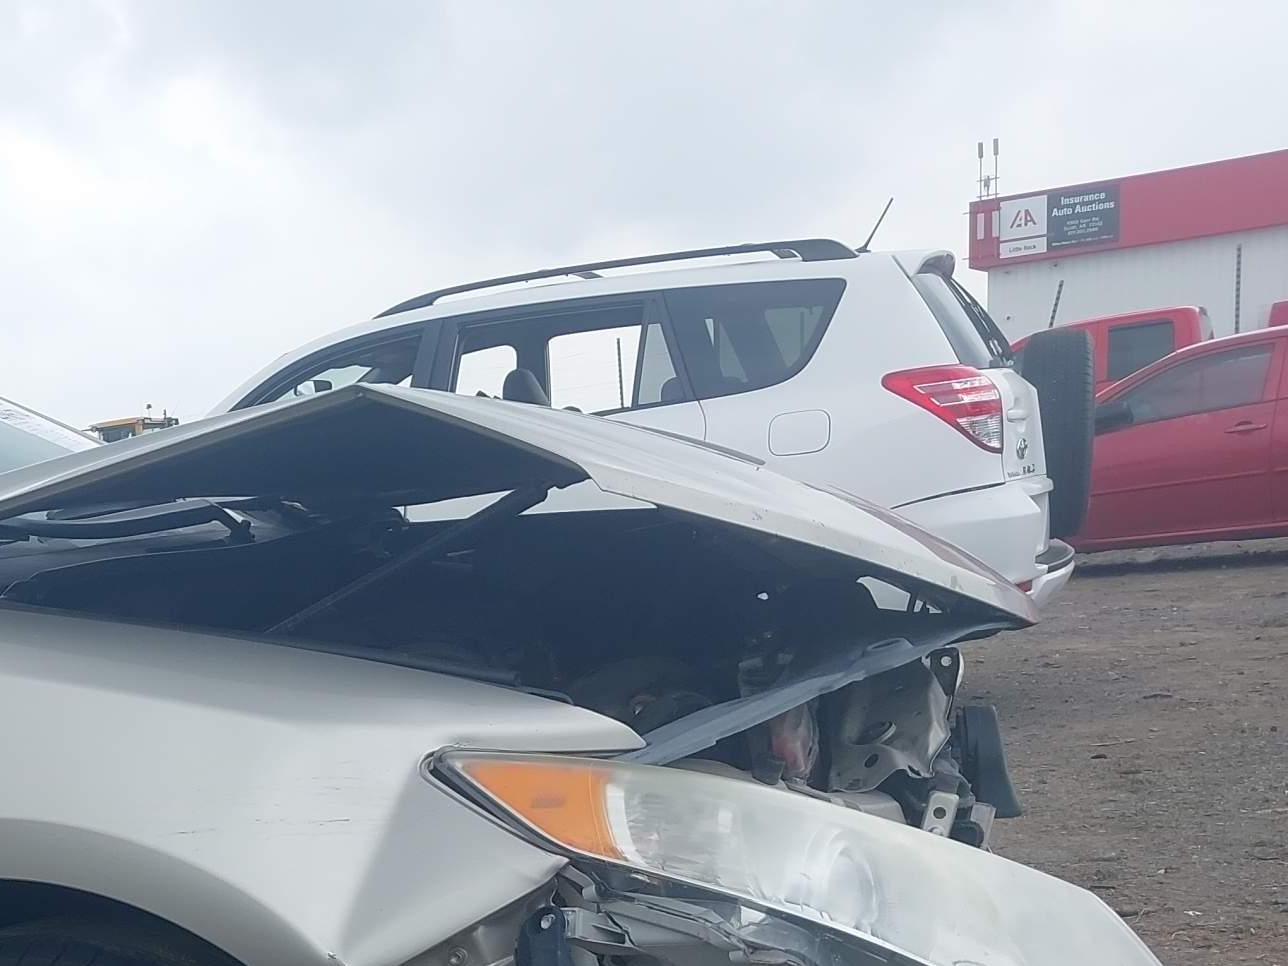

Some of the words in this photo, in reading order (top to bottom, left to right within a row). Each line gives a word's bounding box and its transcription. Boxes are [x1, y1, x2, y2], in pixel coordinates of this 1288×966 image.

[1061, 192, 1106, 205] Insurance
[1051, 207, 1073, 217] Auto
[1075, 201, 1115, 213] Auctions
